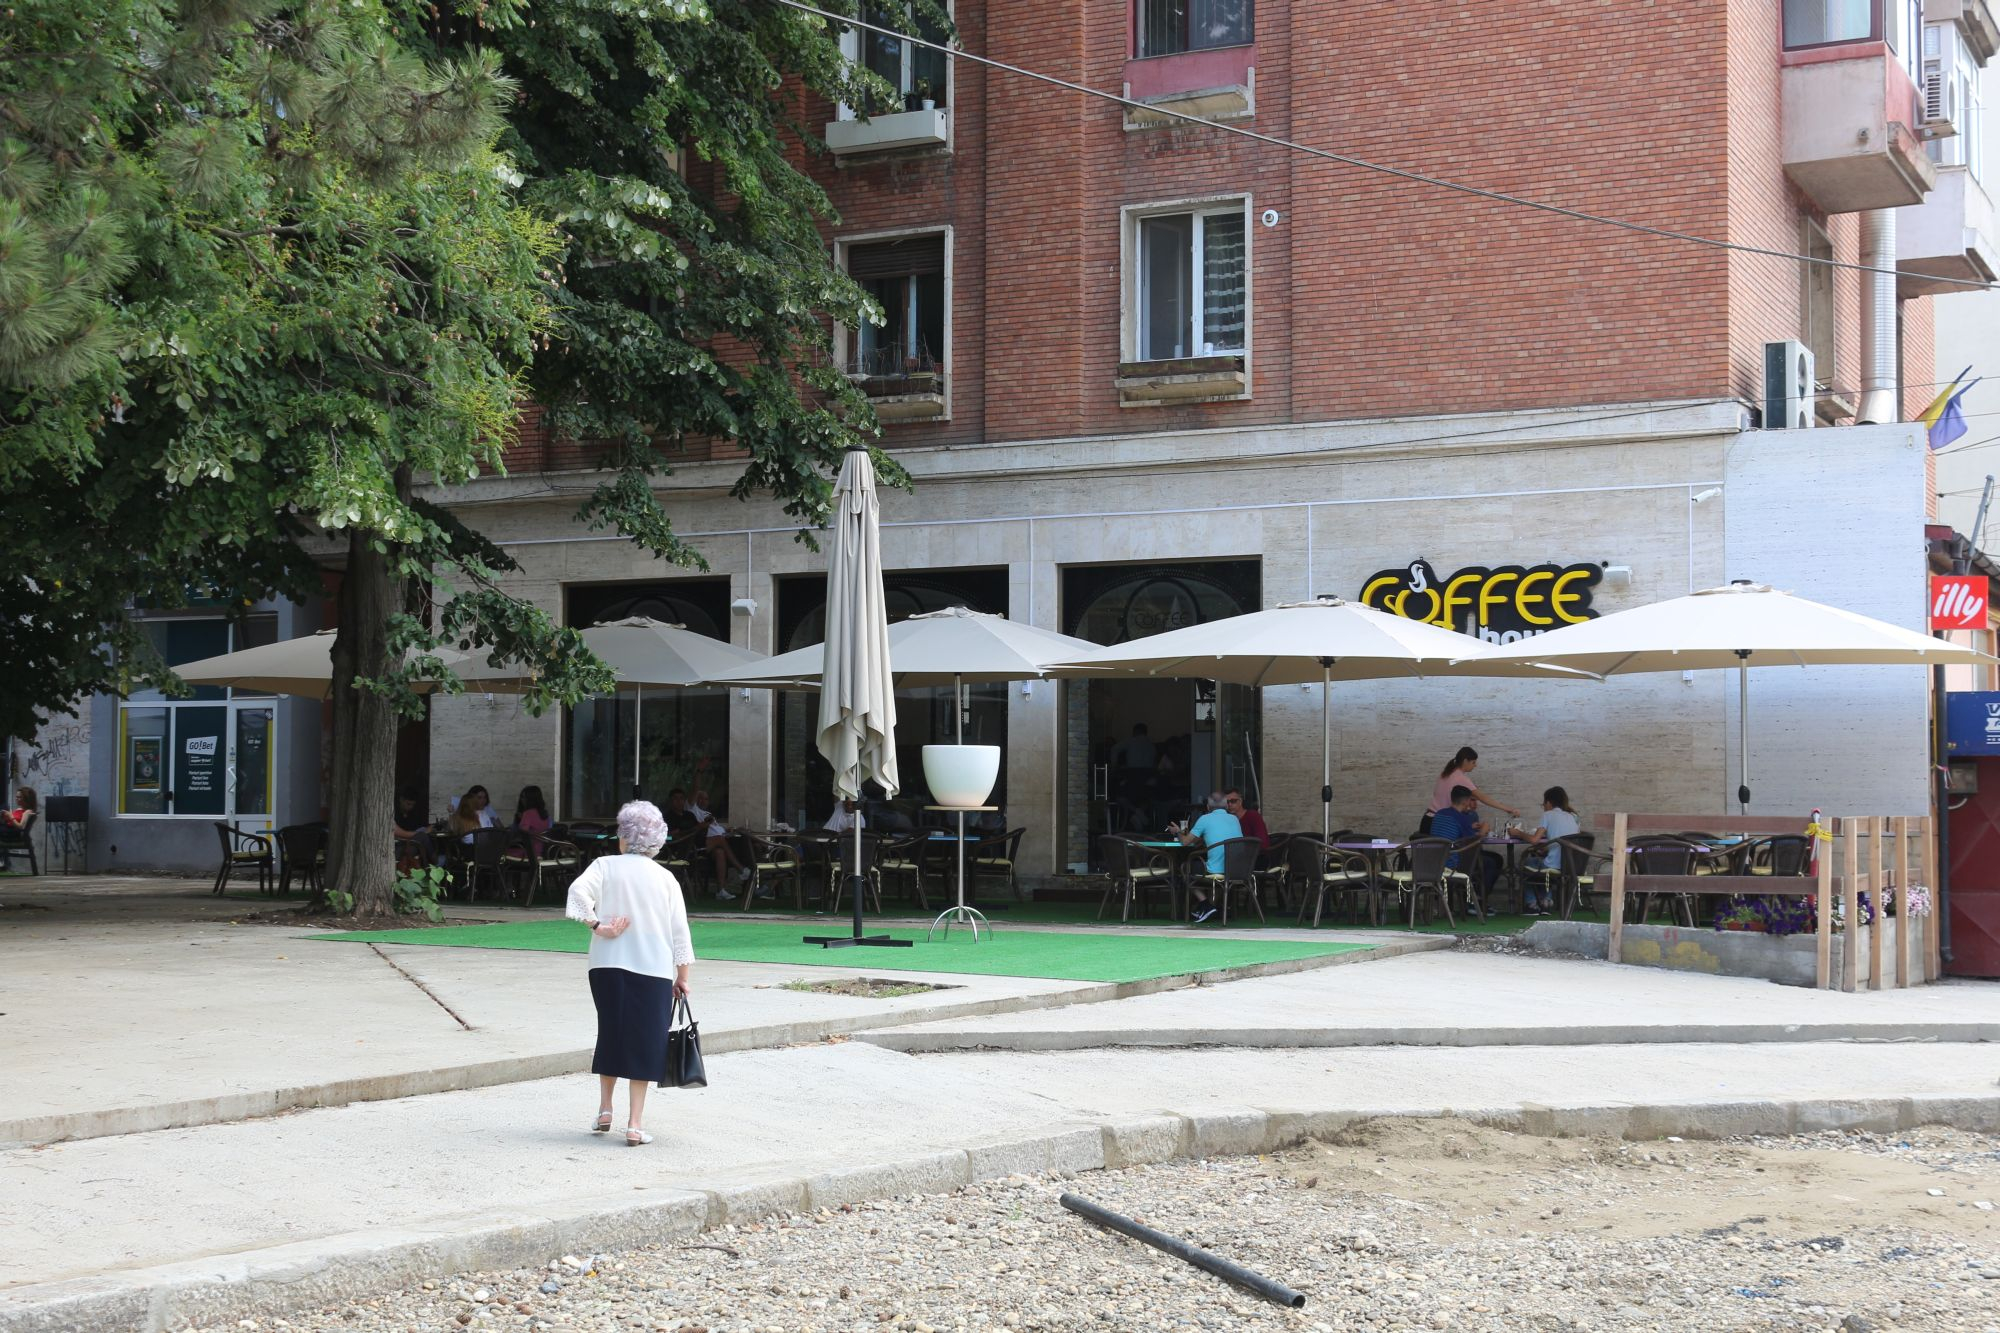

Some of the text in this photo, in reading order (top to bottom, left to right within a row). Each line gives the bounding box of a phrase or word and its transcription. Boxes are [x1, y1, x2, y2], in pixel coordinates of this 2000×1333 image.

[1362, 564, 1591, 630] COFFEE
[1933, 582, 1984, 625] illy
[189, 740, 213, 751] GO!Bet
